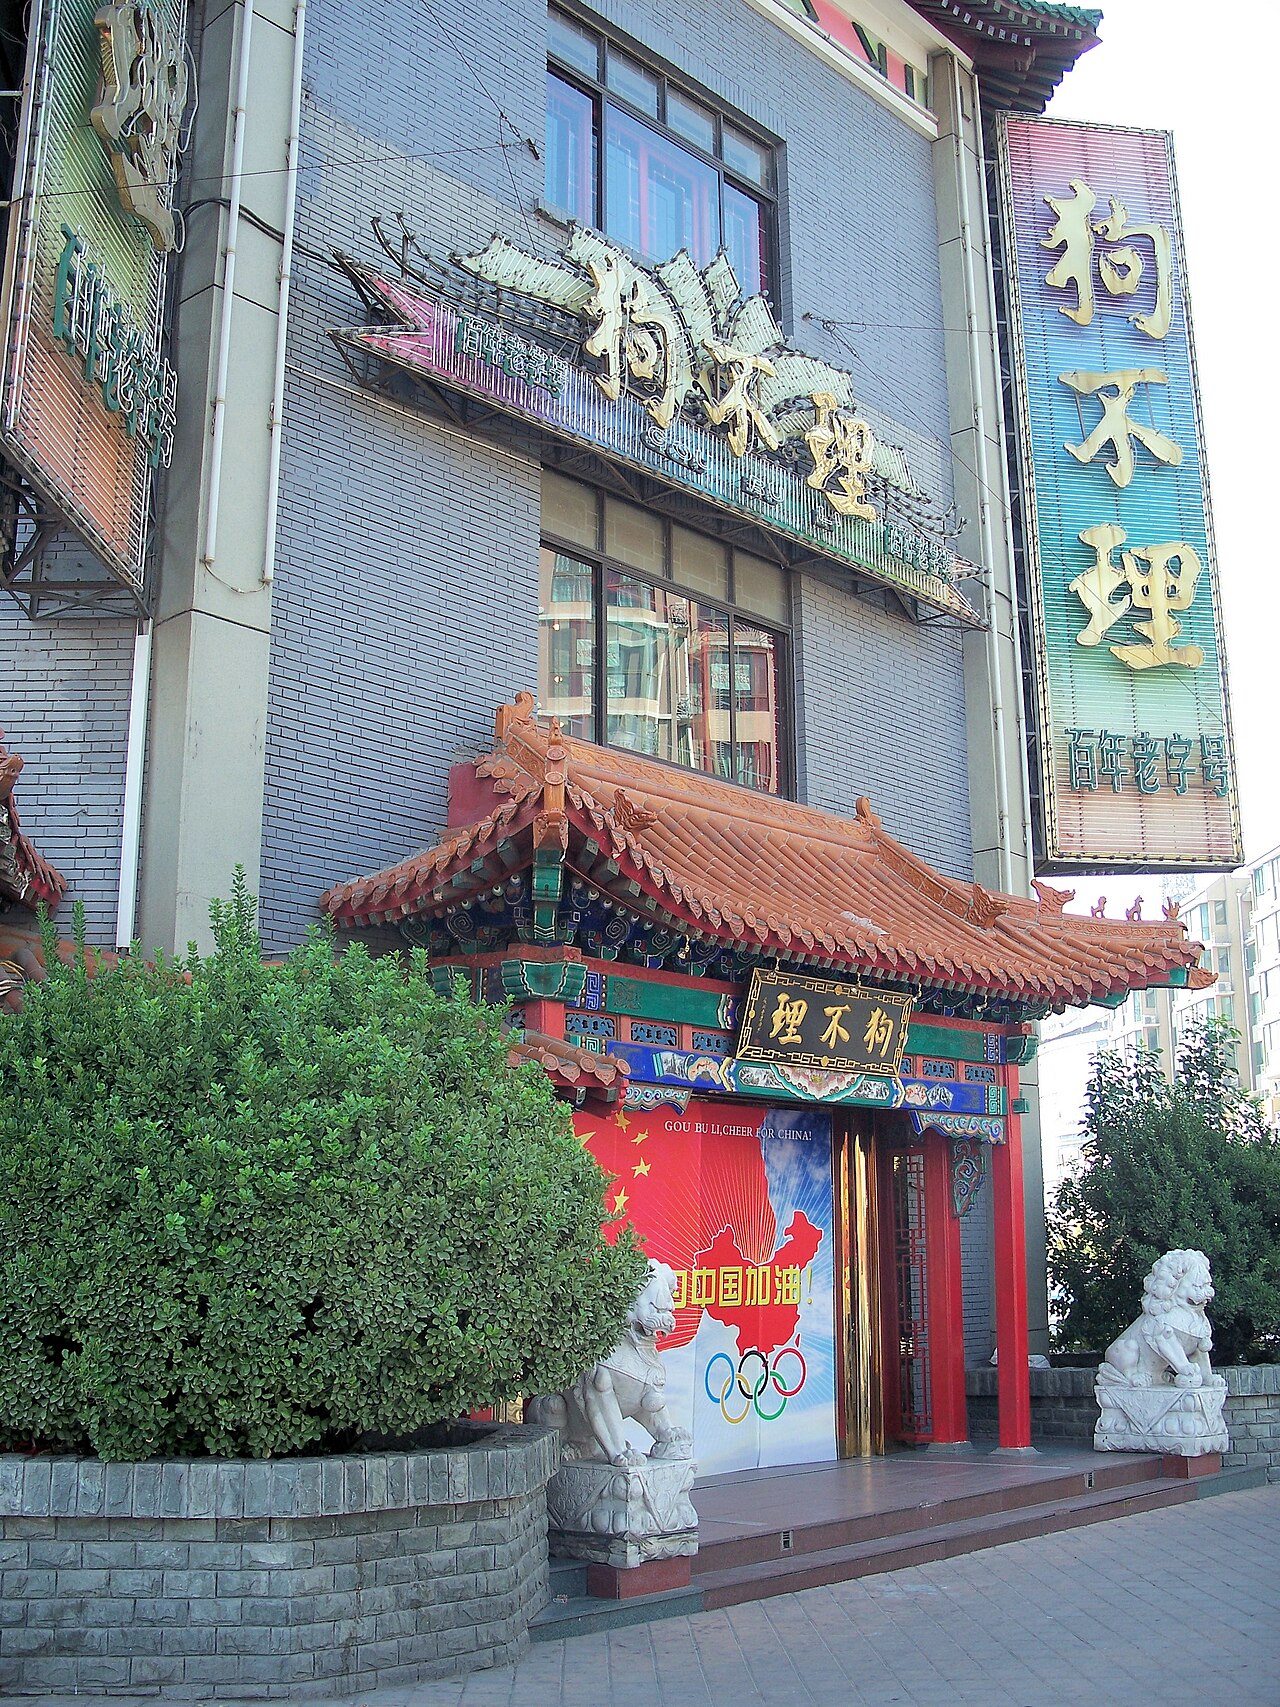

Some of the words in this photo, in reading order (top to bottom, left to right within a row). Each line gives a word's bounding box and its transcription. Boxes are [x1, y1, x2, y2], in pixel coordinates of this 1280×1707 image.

[456, 313, 569, 399] 百年老字号
[576, 254, 877, 523] 狗不理
[1040, 177, 1206, 670] 狗不理
[639, 426, 713, 475] GOU
[740, 474, 786, 506] BU
[1064, 727, 1230, 798] 百年老字号
[768, 992, 894, 1058] 狗不理
[664, 1120, 692, 1133] GOU
[694, 1122, 709, 1134] BU
[711, 1123, 753, 1137] LI,CHEER
[755, 1127, 775, 1139] FOR
[777, 1128, 813, 1141] CHINA!
